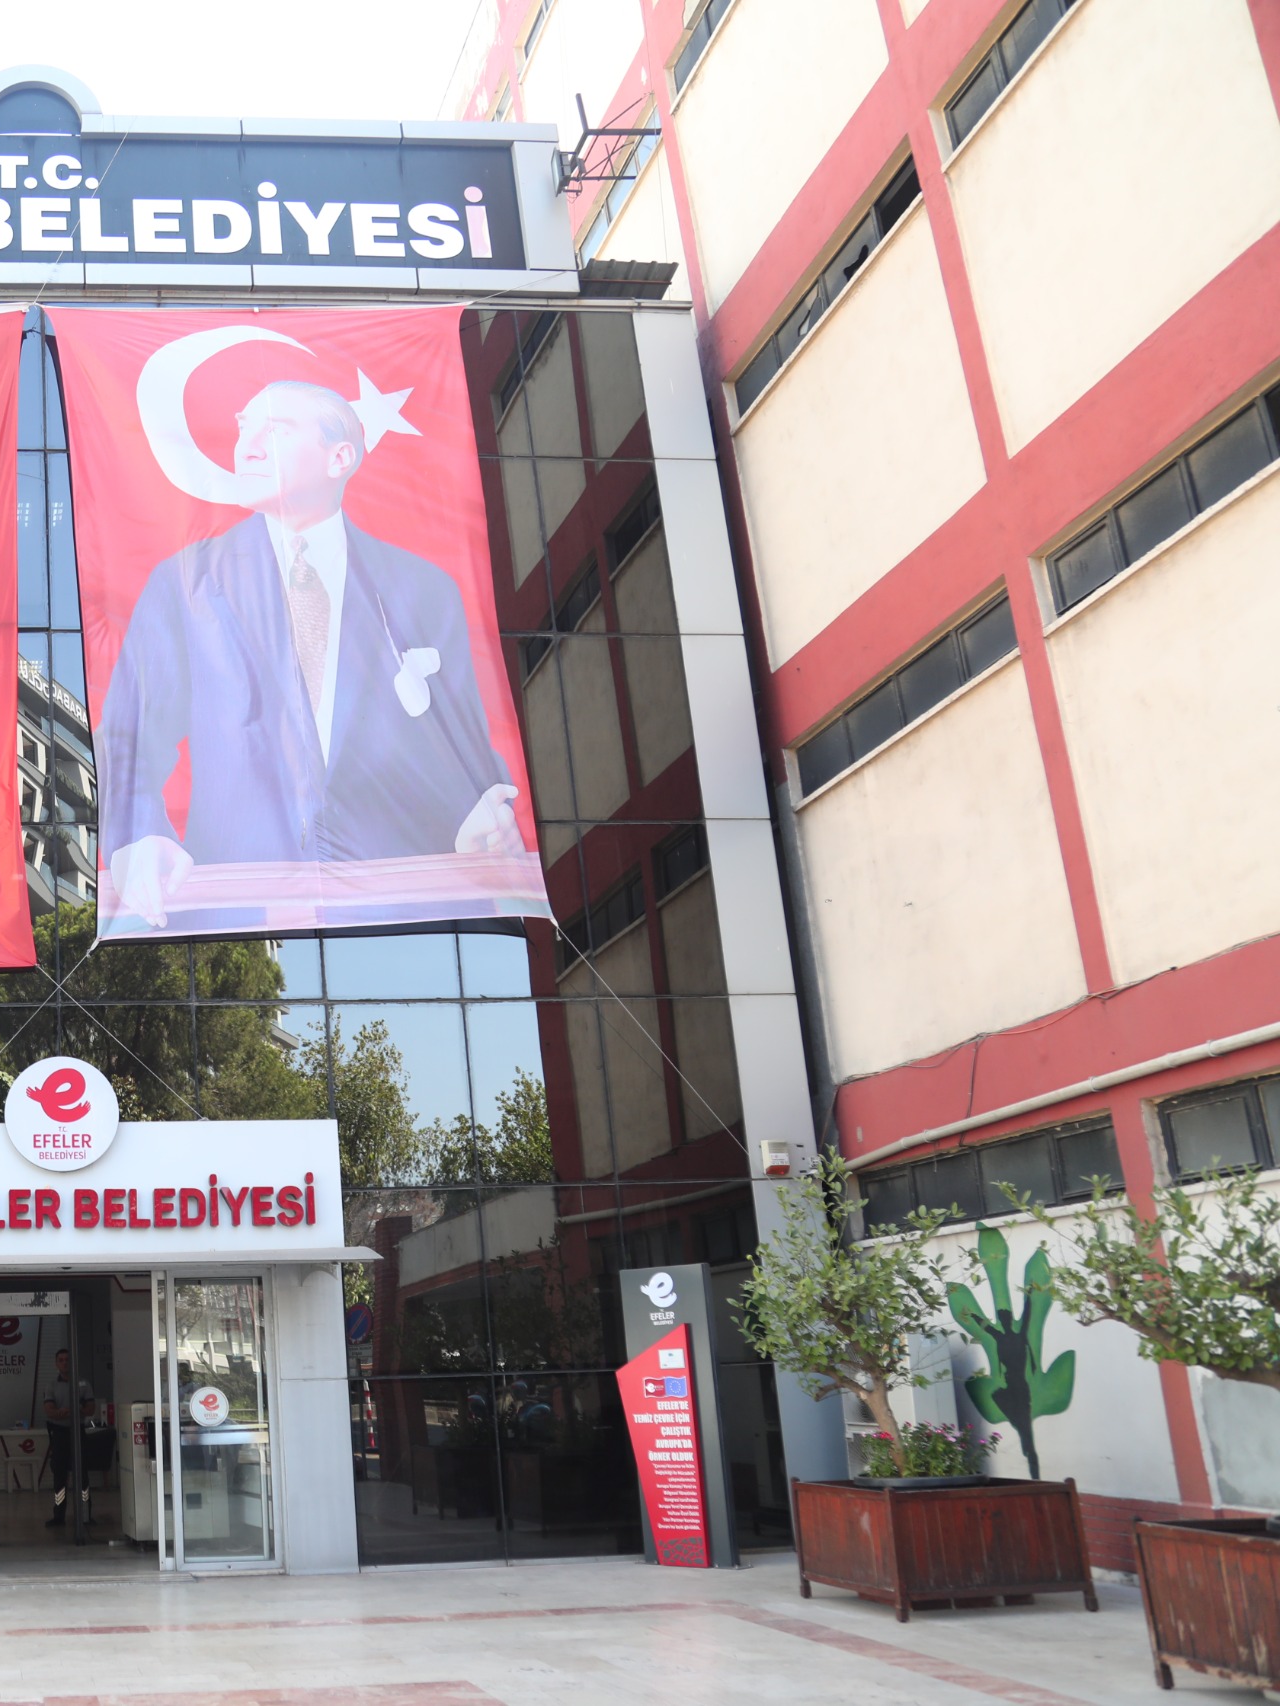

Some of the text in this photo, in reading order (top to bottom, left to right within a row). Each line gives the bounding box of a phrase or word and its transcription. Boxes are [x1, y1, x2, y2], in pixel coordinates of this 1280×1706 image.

[33, 1133, 92, 1149] EFELER
[39, 1150, 87, 1160] BELEDİYESİ
[73, 1171, 317, 1230] BELEDİYESİ
[650, 1311, 675, 1321] EFELER
